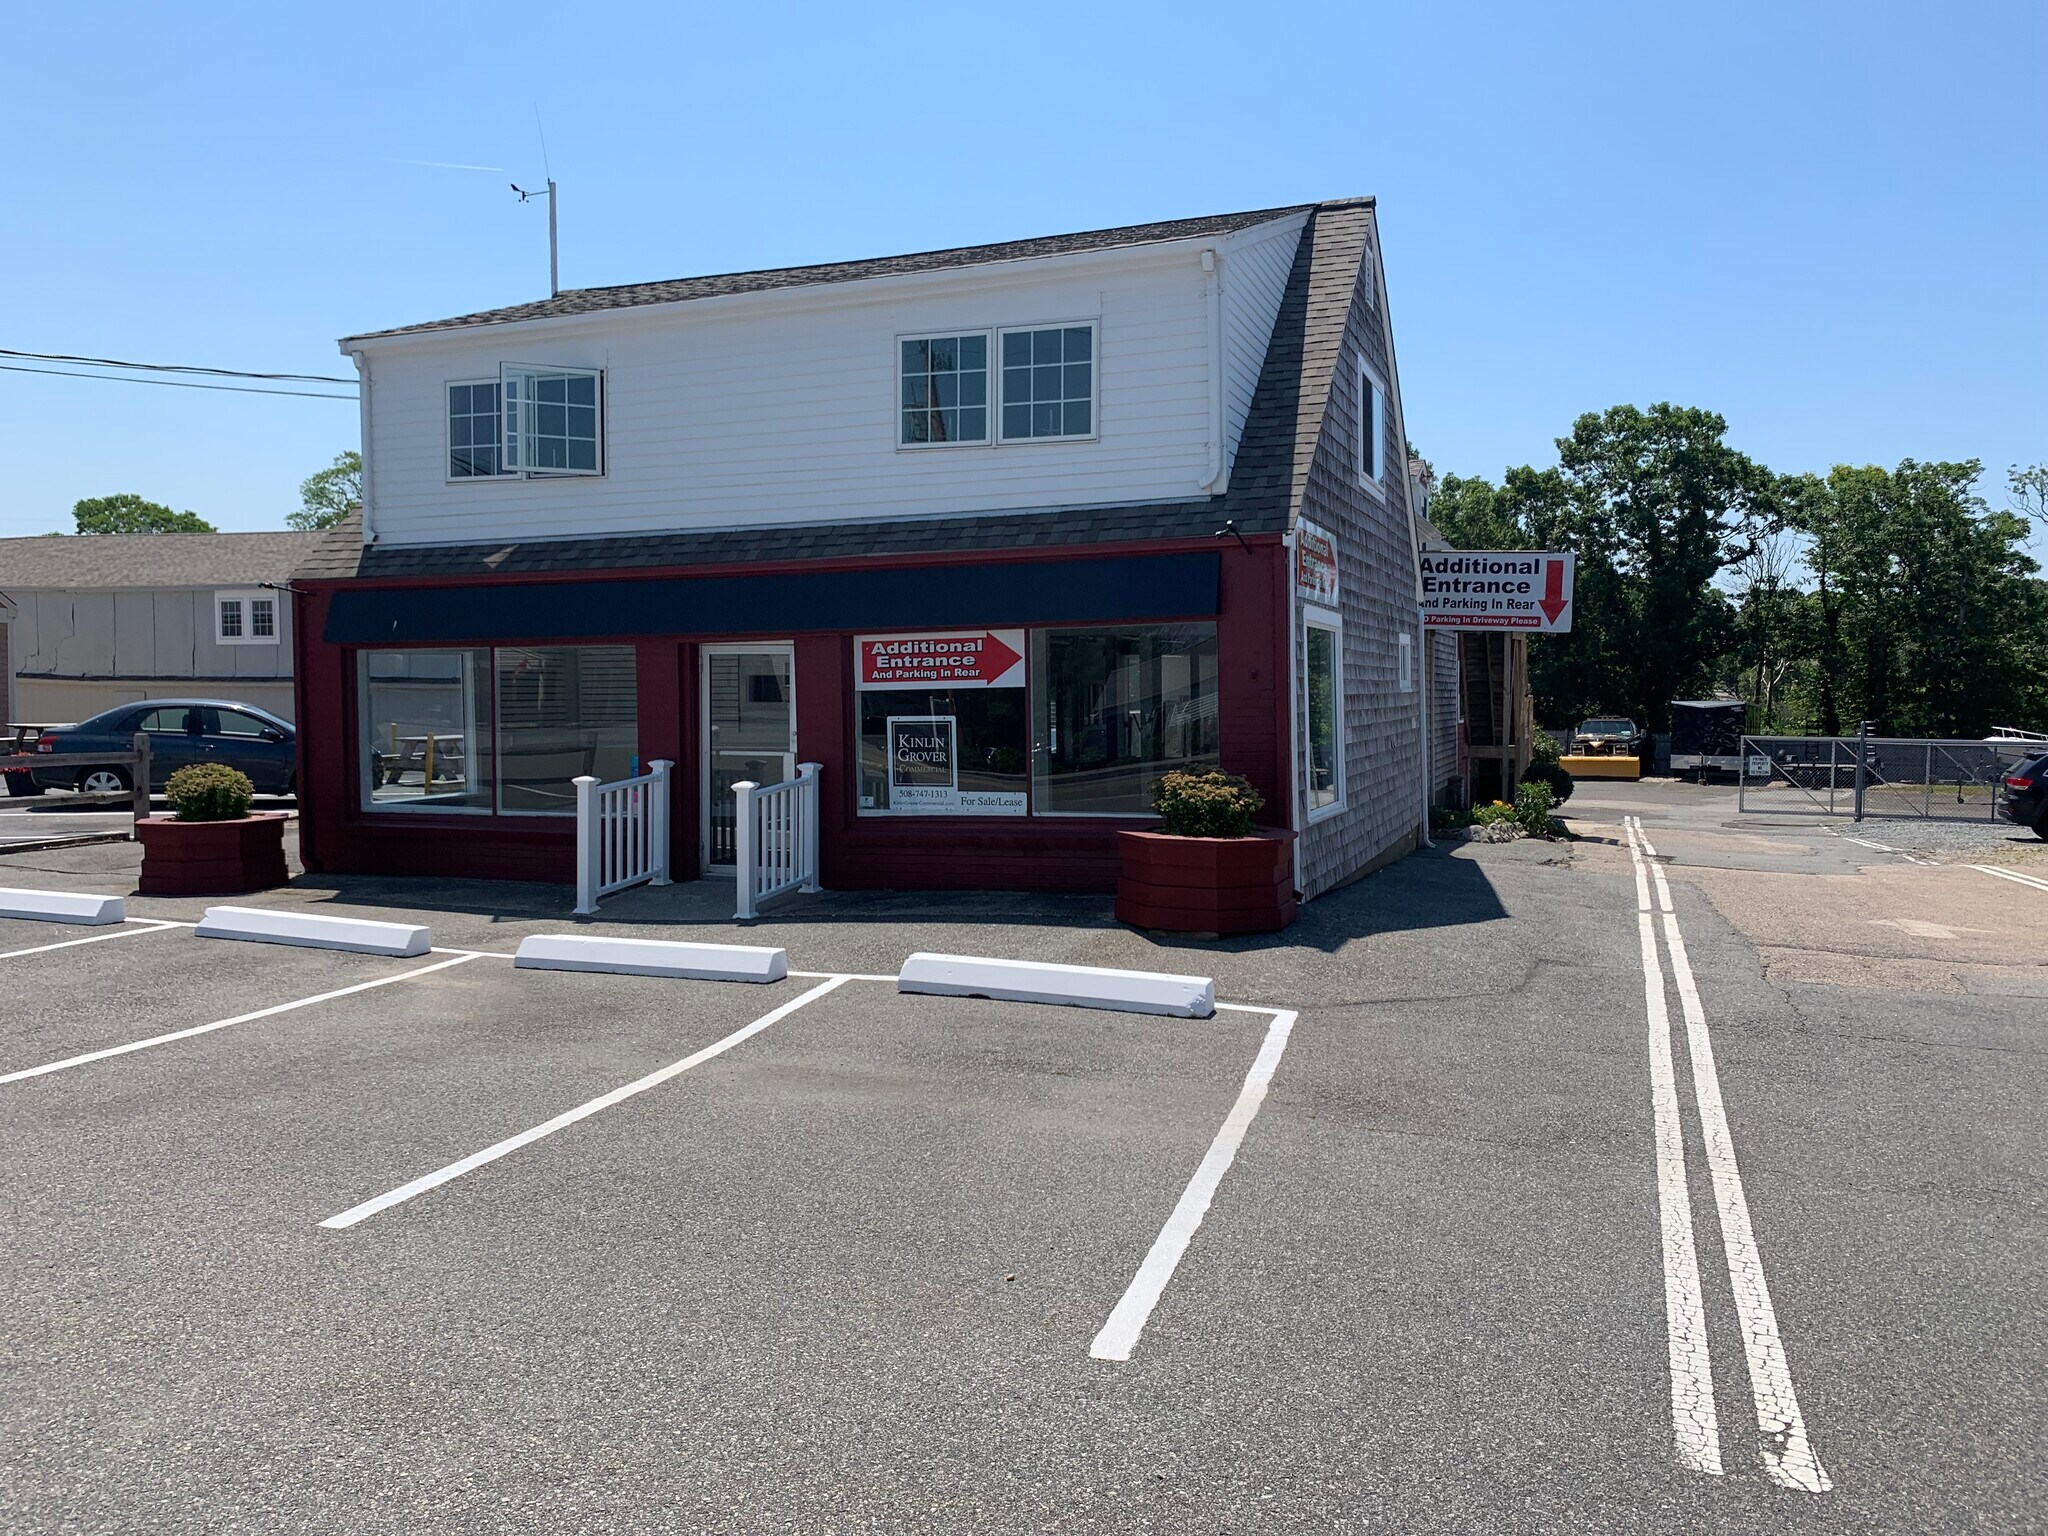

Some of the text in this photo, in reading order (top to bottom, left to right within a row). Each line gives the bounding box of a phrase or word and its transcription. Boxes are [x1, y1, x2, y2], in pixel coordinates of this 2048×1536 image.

[1421, 557, 1540, 575] Additional
[1423, 576, 1531, 594] Entrance
[1442, 598, 1487, 611] Parking
[1491, 598, 1503, 610] In
[1506, 599, 1535, 610] Rear
[1430, 615, 1460, 624] Parking
[1462, 616, 1470, 624] In
[1472, 616, 1509, 625] Driveway
[1511, 617, 1538, 625] Please
[871, 639, 984, 655] Additional
[876, 655, 976, 668] Entrance
[872, 668, 981, 680] And Parking In Rear
[898, 734, 945, 749] KINLIN
[898, 748, 947, 763] GROVER
[899, 790, 948, 799] 508-747-1313
[961, 796, 1023, 807] For Sale/Lease
